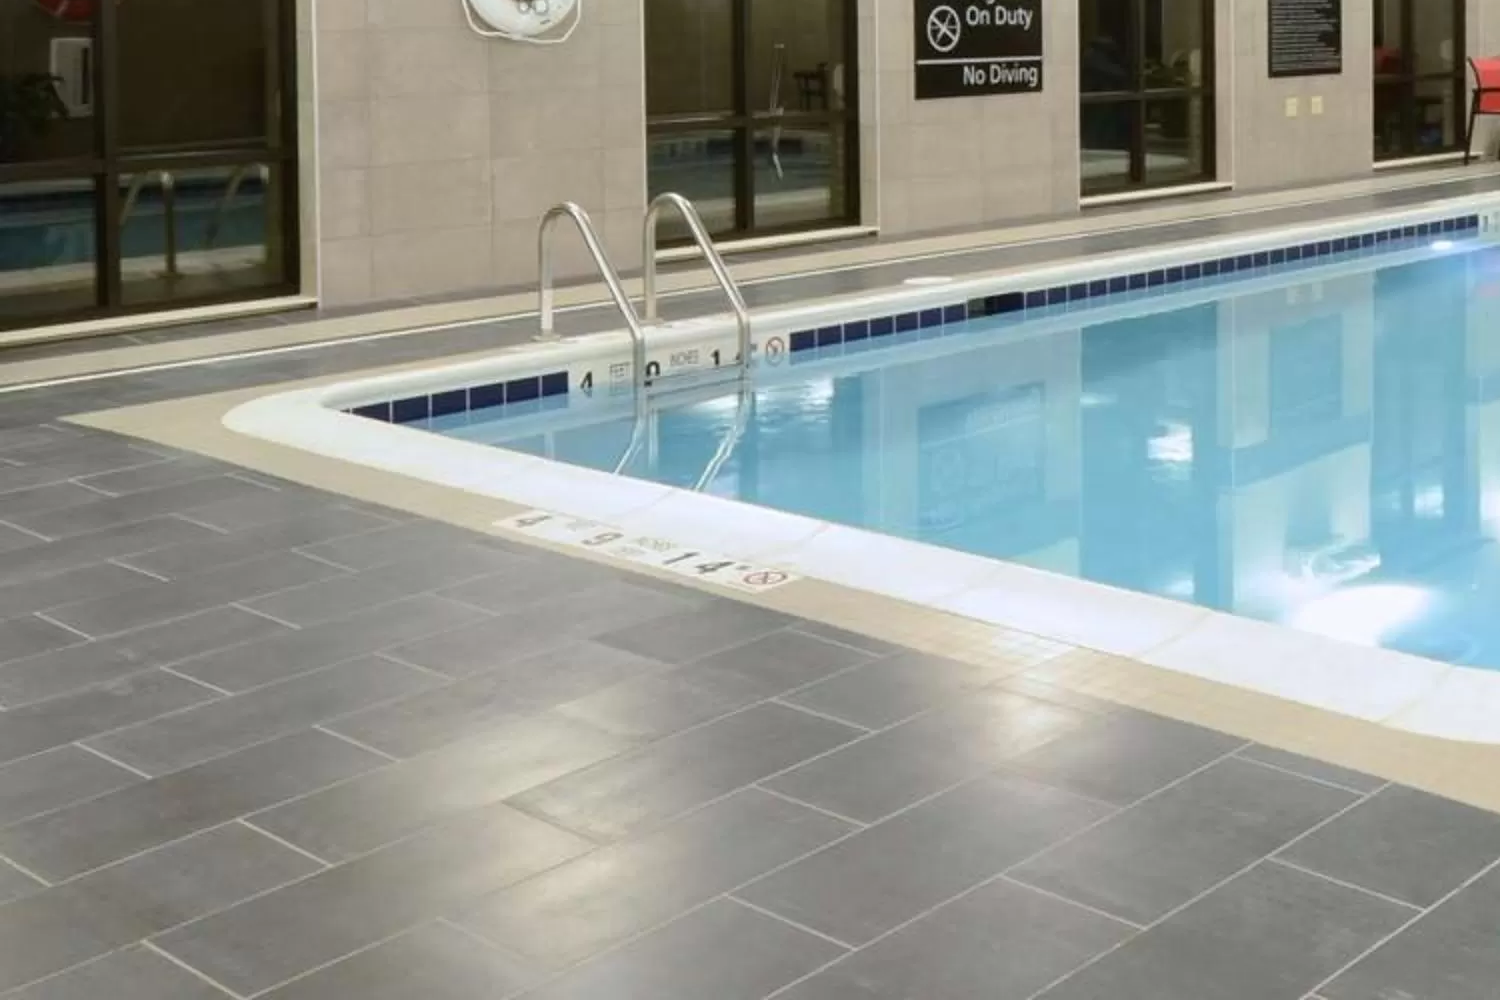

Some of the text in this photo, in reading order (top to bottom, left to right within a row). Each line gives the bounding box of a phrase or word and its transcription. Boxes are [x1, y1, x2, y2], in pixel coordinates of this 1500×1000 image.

[966, 6, 1033, 31] On Duty
[963, 63, 1037, 87] No Diving
